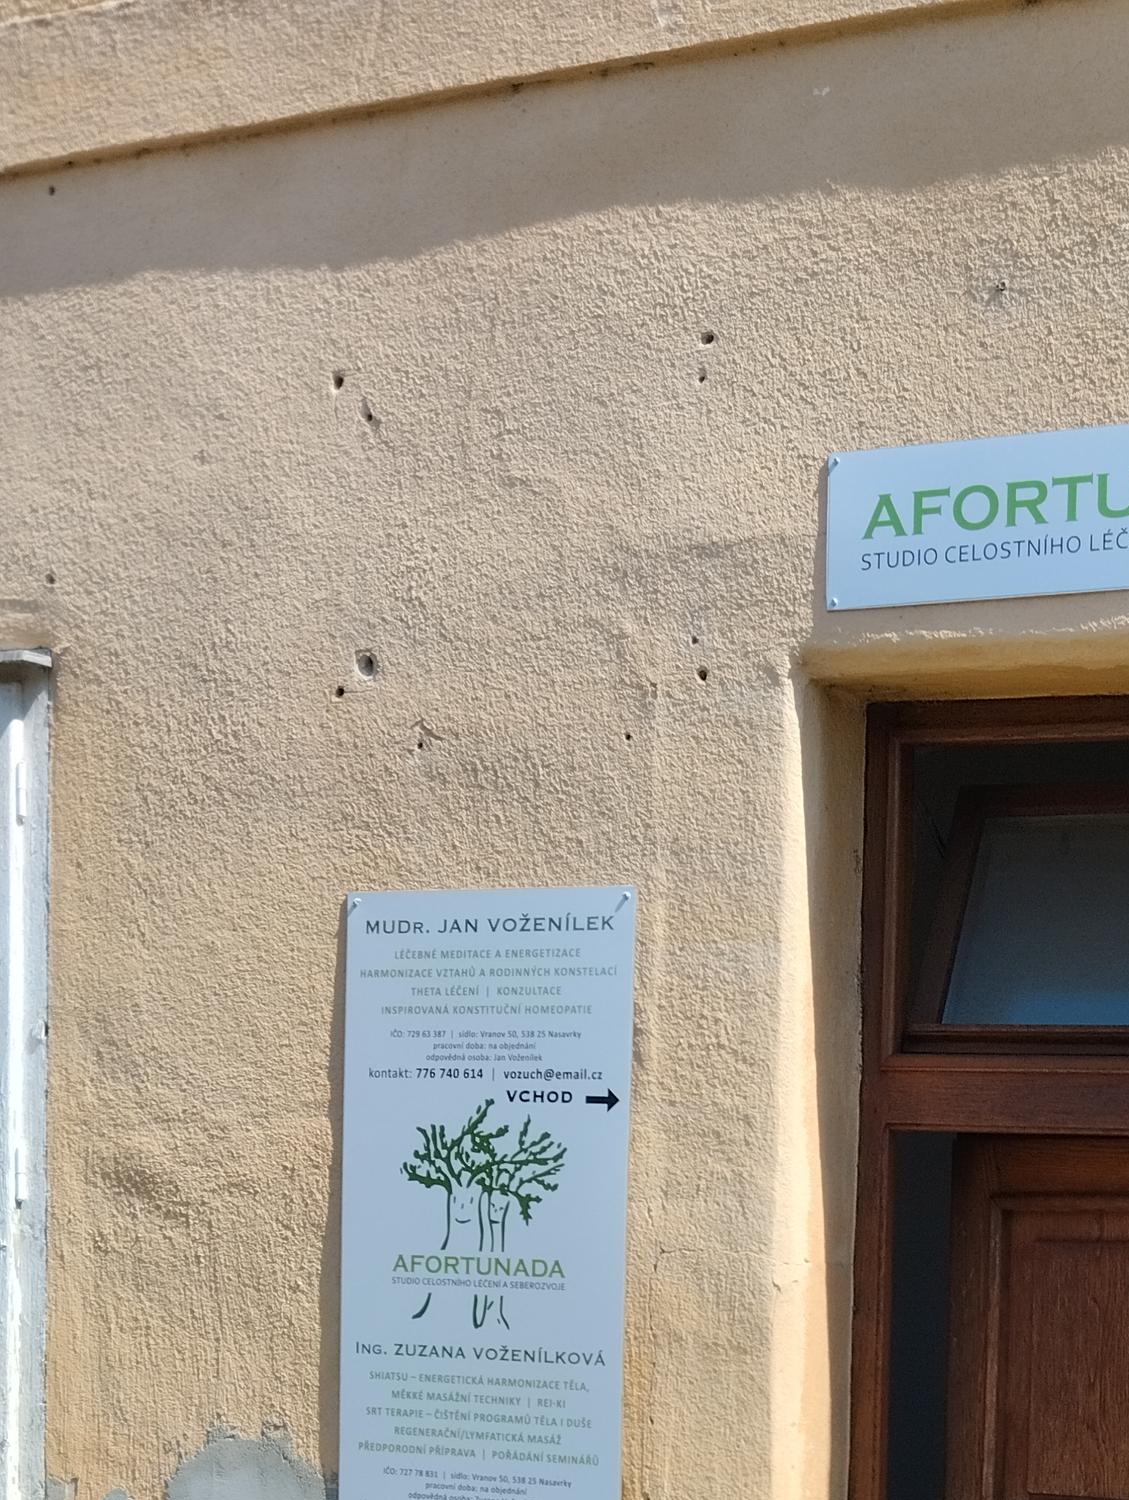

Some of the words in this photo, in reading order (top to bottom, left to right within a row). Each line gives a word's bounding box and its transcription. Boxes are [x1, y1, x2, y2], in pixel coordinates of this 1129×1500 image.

[860, 547, 938, 571] STUDIO
[945, 532, 1081, 564] CELOSTNÍHO
[437, 919, 479, 933] JAN
[487, 912, 615, 932] VOŽENÍLEK
[394, 948, 437, 960] LÉČEBNÉ
[440, 949, 491, 959] MEDITACE
[494, 949, 502, 958] A
[505, 948, 581, 958] ENERGETIZACE
[360, 968, 432, 978] HARMONIZACE
[479, 968, 486, 977] A
[489, 965, 551, 977] RODINNÝCH
[554, 965, 617, 976] KONSTELACÍ
[411, 987, 441, 996] THETA
[445, 985, 480, 996] LÉČENÍ
[497, 986, 562, 996] KONZULTACE
[381, 1003, 449, 1015] INSPIROVANÁ
[453, 1003, 521, 1014] KONSTITUČNÍ
[524, 1004, 592, 1014] HOMEOPATIE
[422, 1030, 431, 1038] 63
[433, 1030, 446, 1038] 387
[480, 1030, 505, 1038] Vranov
[548, 1030, 582, 1040] Nasavrky
[433, 1042, 464, 1050] pracovní
[368, 1067, 413, 1079] kontakt:
[416, 1068, 436, 1079] 776
[439, 1068, 460, 1079] 740
[463, 1068, 483, 1079] 614
[503, 1068, 603, 1081] vozuch@email.cz
[506, 1090, 573, 1103] VCHOD
[392, 1254, 566, 1278] AFORTUNADA
[391, 1276, 421, 1285] STUDIO
[422, 1277, 472, 1288] CELOSTNÍHO
[473, 1278, 501, 1289] LÉČENÍ
[510, 1281, 566, 1291] SEBEROZVOJE
[394, 1343, 466, 1359] ZUZANA
[472, 1345, 606, 1366] VOŽENÍLKOVÁ
[369, 1370, 408, 1381] SHIATSU
[419, 1373, 485, 1385] ENERGETICKÁ
[487, 1377, 560, 1390] HARMONIZACE
[426, 1391, 471, 1403] MASÁŽNÍ
[474, 1394, 521, 1406] TECHNIKY
[537, 1398, 566, 1408] REI-KI
[366, 1406, 382, 1416] SRT
[385, 1407, 424, 1418] TERAPIE
[434, 1408, 471, 1421] ČIŠTĚNÍ
[534, 1414, 558, 1427] TĚLA
[566, 1417, 593, 1429] DUŠE
[527, 1434, 562, 1445] MASÁŽ
[358, 1440, 426, 1455] PŘEDPORODNÍ
[428, 1445, 476, 1458] PŘÍPRAVA
[471, 1473, 498, 1482] Vranov
